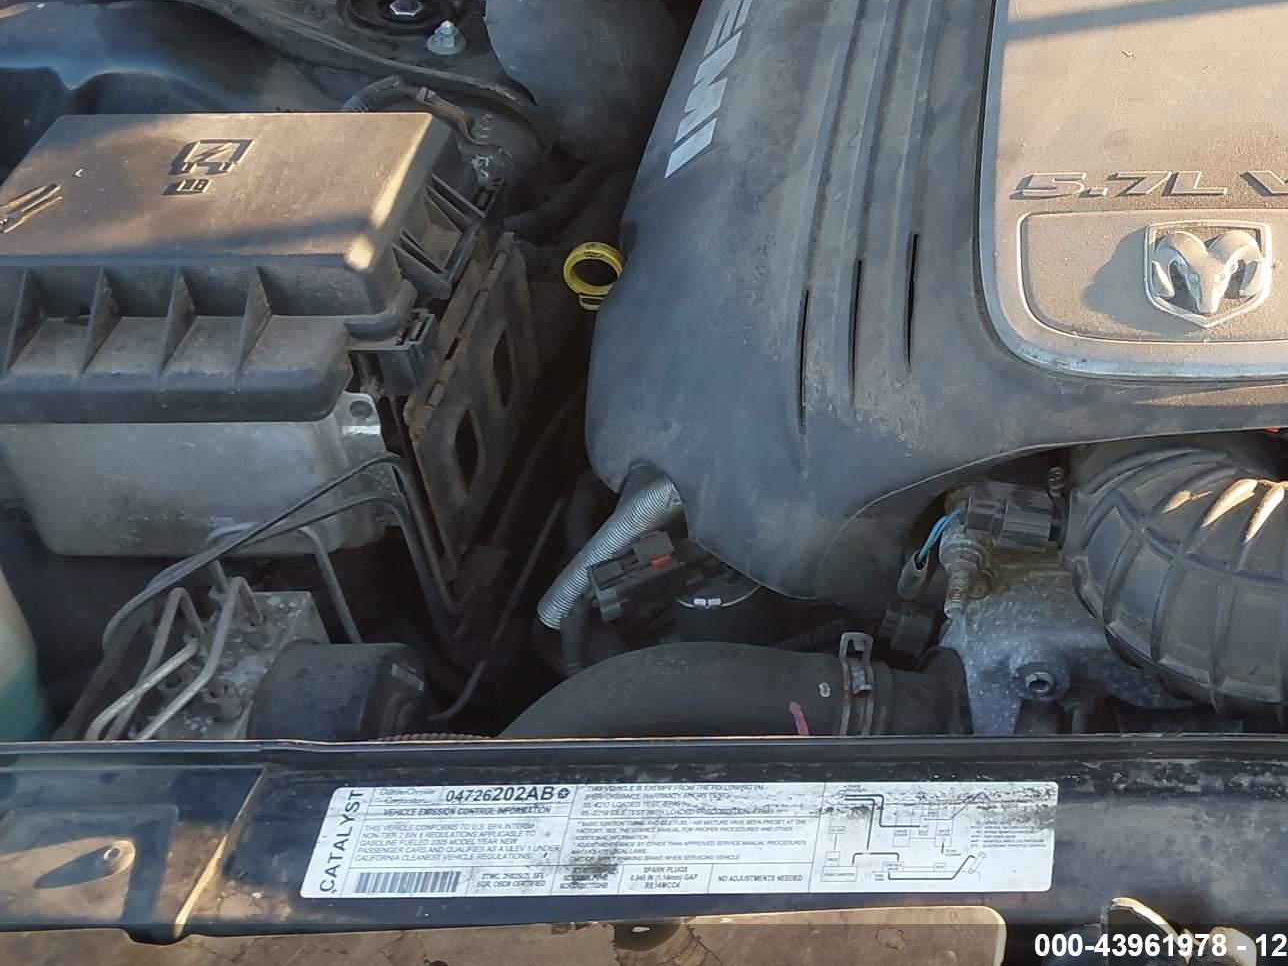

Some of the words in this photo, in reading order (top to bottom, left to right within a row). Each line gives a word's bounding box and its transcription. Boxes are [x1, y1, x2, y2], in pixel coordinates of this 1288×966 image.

[1014, 170, 1228, 198] 5.7L
[445, 786, 553, 803] 04726202AB
[319, 789, 364, 894] CATALYST
